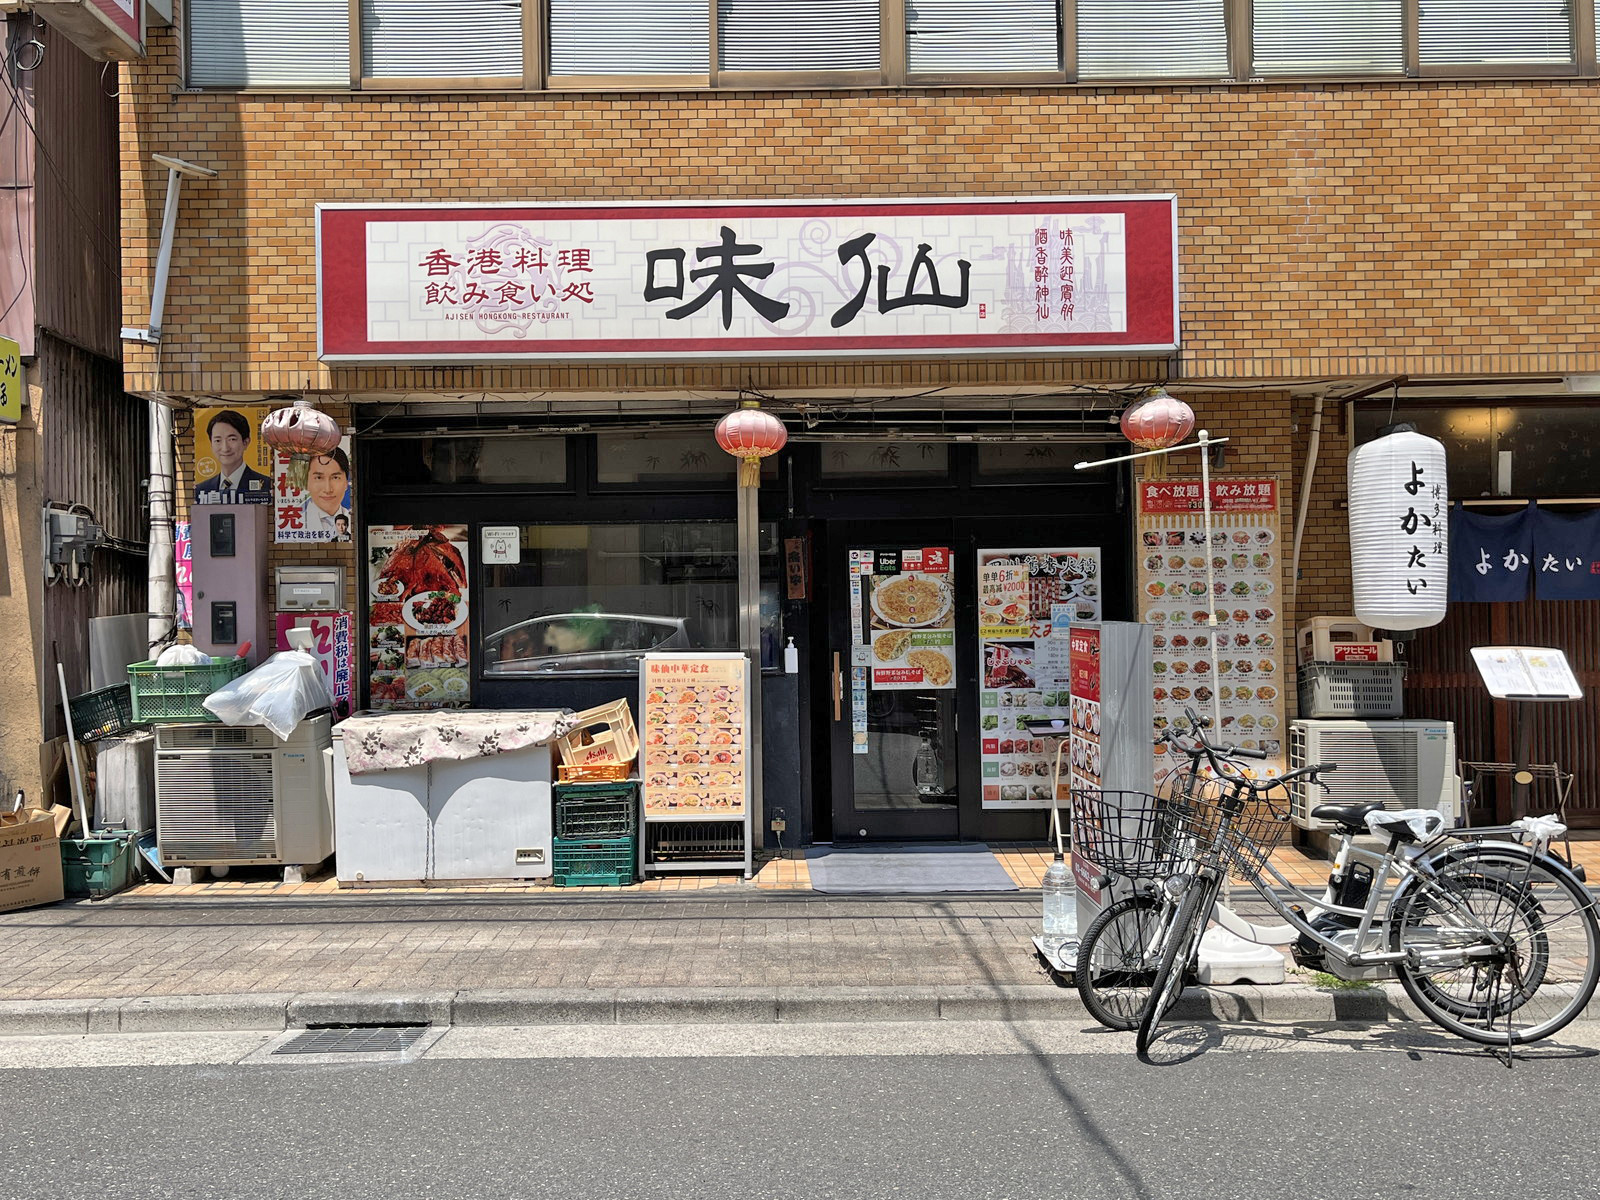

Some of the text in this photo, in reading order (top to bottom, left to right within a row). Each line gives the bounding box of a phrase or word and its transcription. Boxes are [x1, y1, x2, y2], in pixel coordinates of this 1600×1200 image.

[418, 248, 594, 277] 香港料理
[643, 226, 971, 331] 味仙
[425, 281, 594, 305] 飲み食い処
[0, 354, 17, 378] メン
[1146, 483, 1271, 498] 食べ放題 飲み放題
[1400, 460, 1431, 595] よかたい
[1431, 484, 1444, 555] 博多料理
[277, 530, 336, 539] 科学で政治を斬る!
[879, 558, 897, 566] Uber
[1475, 547, 1583, 576] よかたい
[1335, 646, 1377, 654] アサヒビール
[651, 664, 709, 674] 味仙中華定食
[586, 746, 608, 760] Asahi
[607, 752, 614, 761] 20
